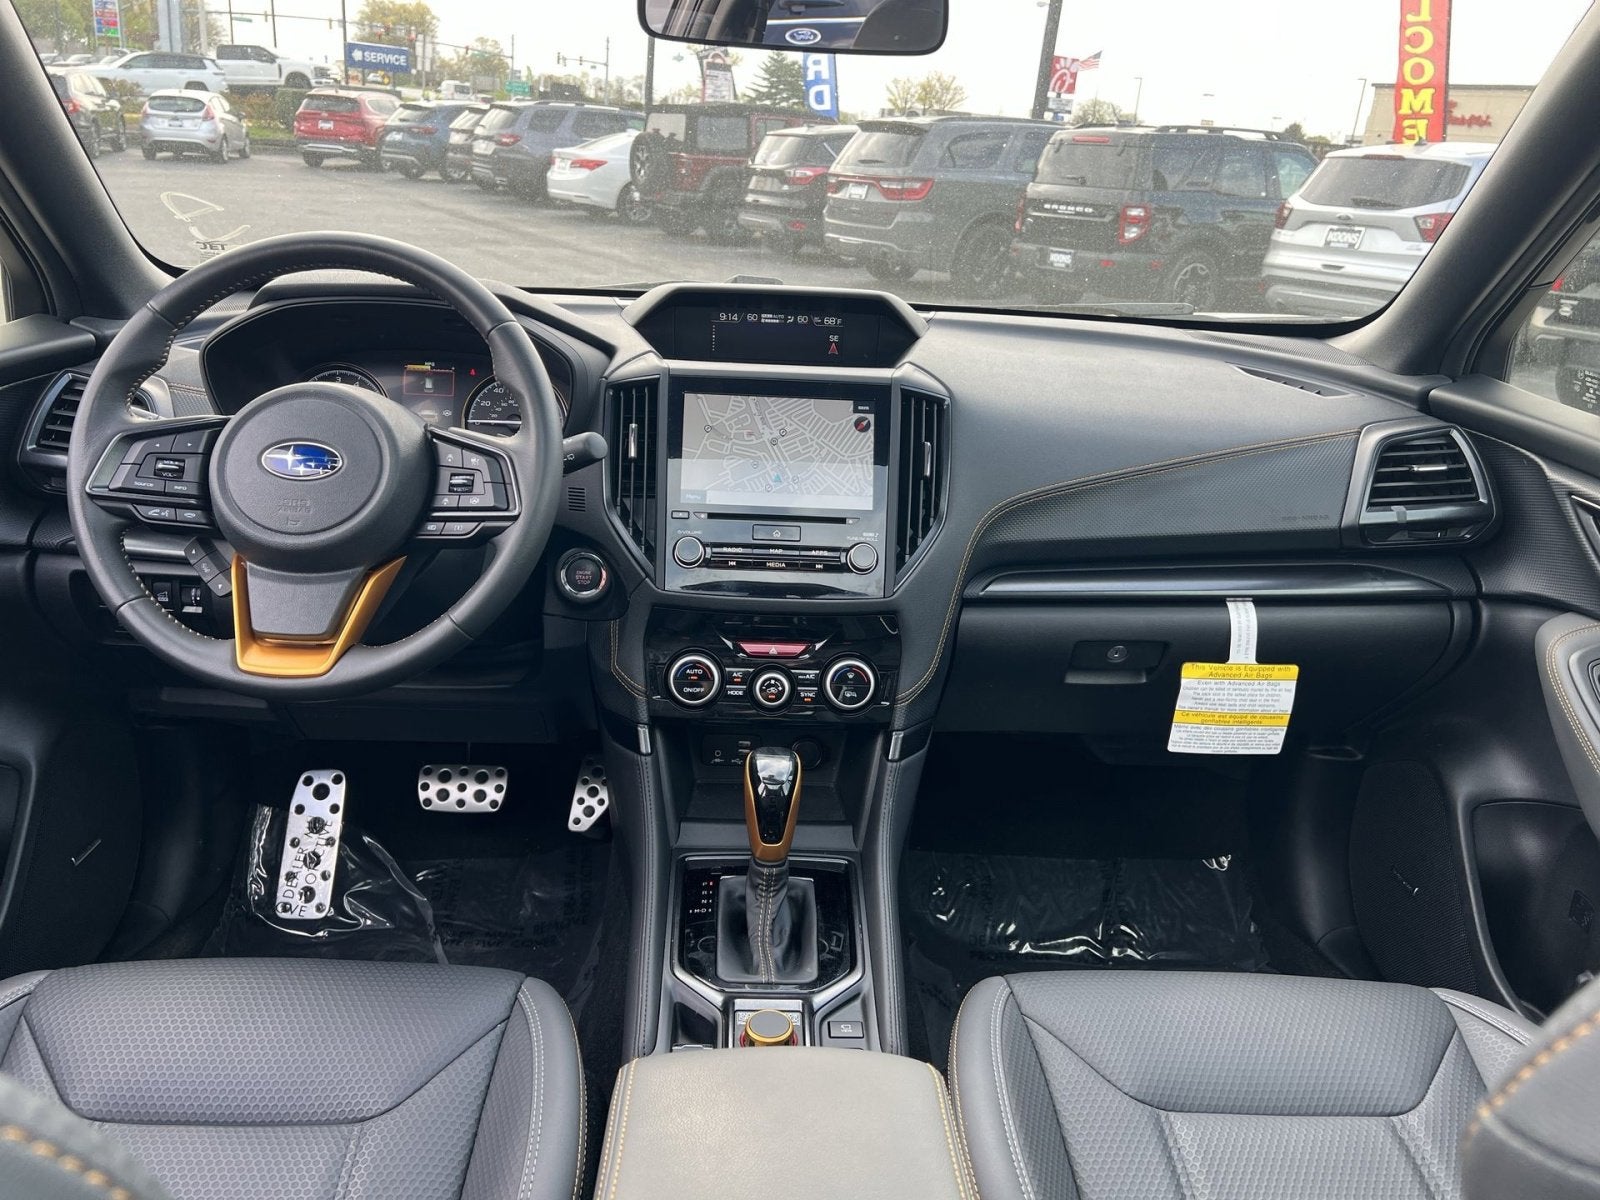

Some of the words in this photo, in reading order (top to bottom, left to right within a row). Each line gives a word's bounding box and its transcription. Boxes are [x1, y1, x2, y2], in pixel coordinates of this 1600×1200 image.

[364, 52, 407, 66] SERVICE
[1326, 230, 1360, 244] KOONS
[720, 312, 738, 321] 9:14
[746, 313, 758, 321] 60
[797, 316, 808, 324] 60
[1244, 665, 1275, 673] Equipped
